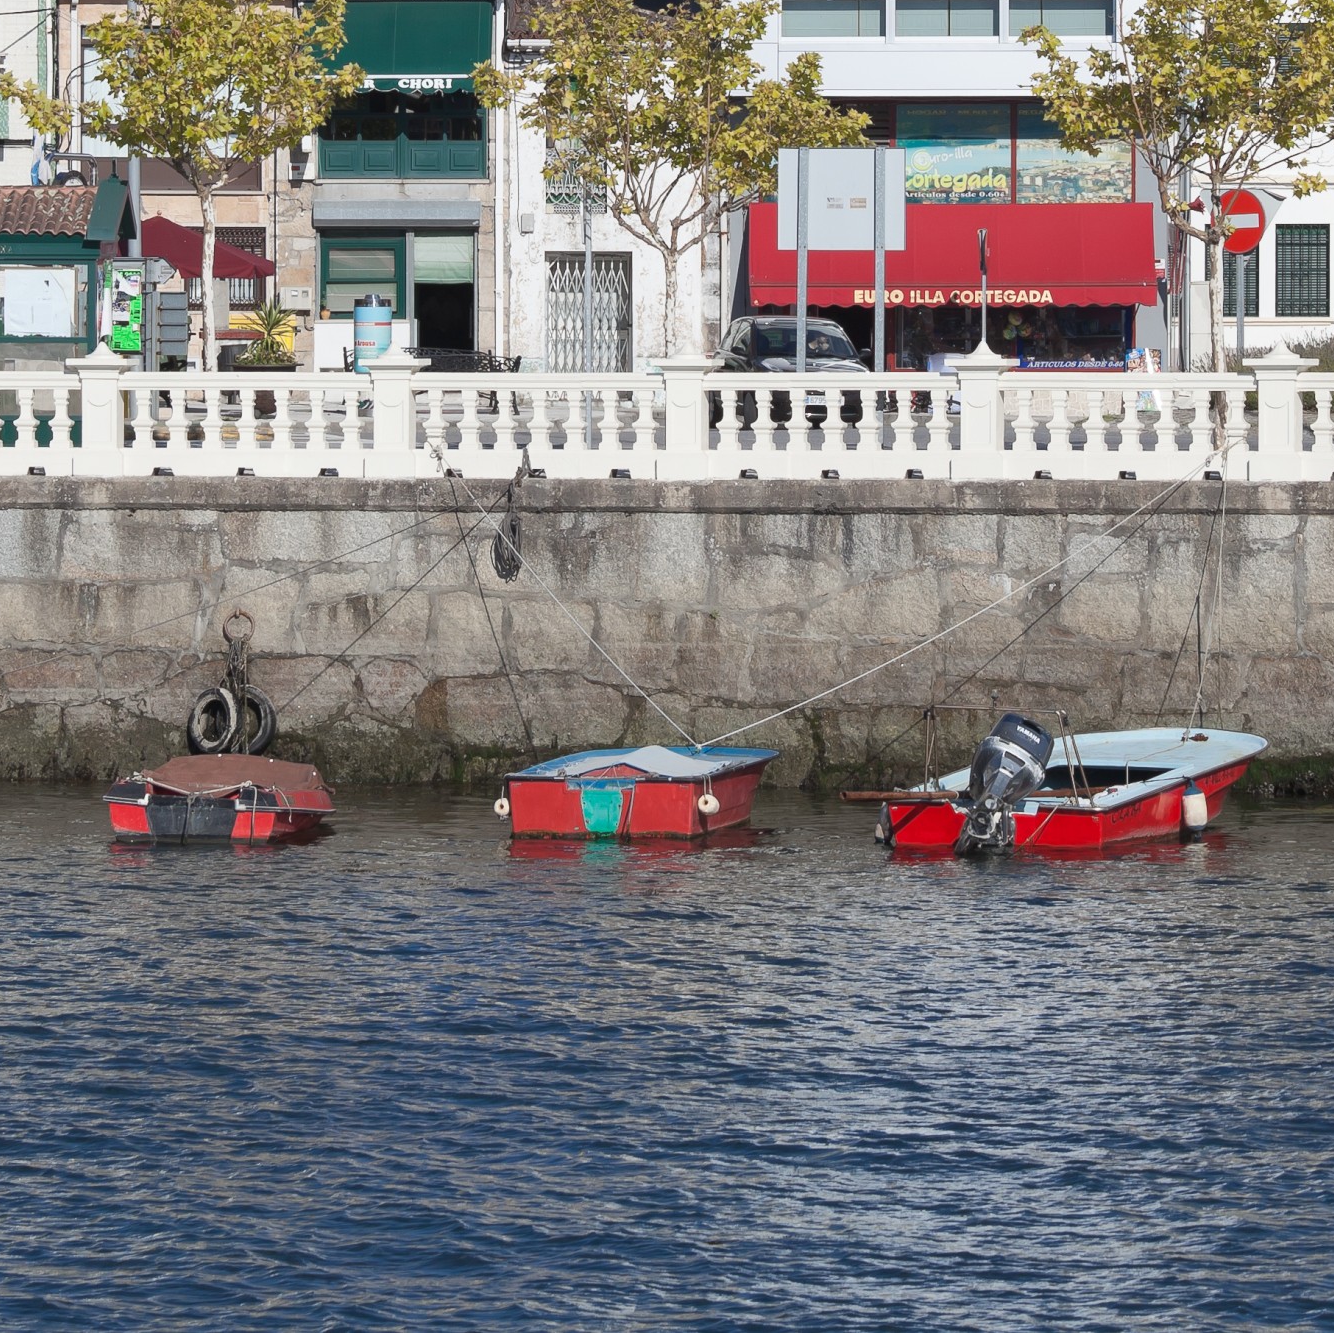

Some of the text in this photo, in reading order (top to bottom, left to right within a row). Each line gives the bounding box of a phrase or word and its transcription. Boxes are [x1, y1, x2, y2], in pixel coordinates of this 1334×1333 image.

[398, 78, 453, 89] CHORI
[948, 191, 977, 199] desde
[910, 290, 945, 304] ILLA
[950, 290, 1053, 304] CORTEGADA
[1077, 360, 1107, 368] DESDE
[1017, 725, 1041, 745] YAMAHA
